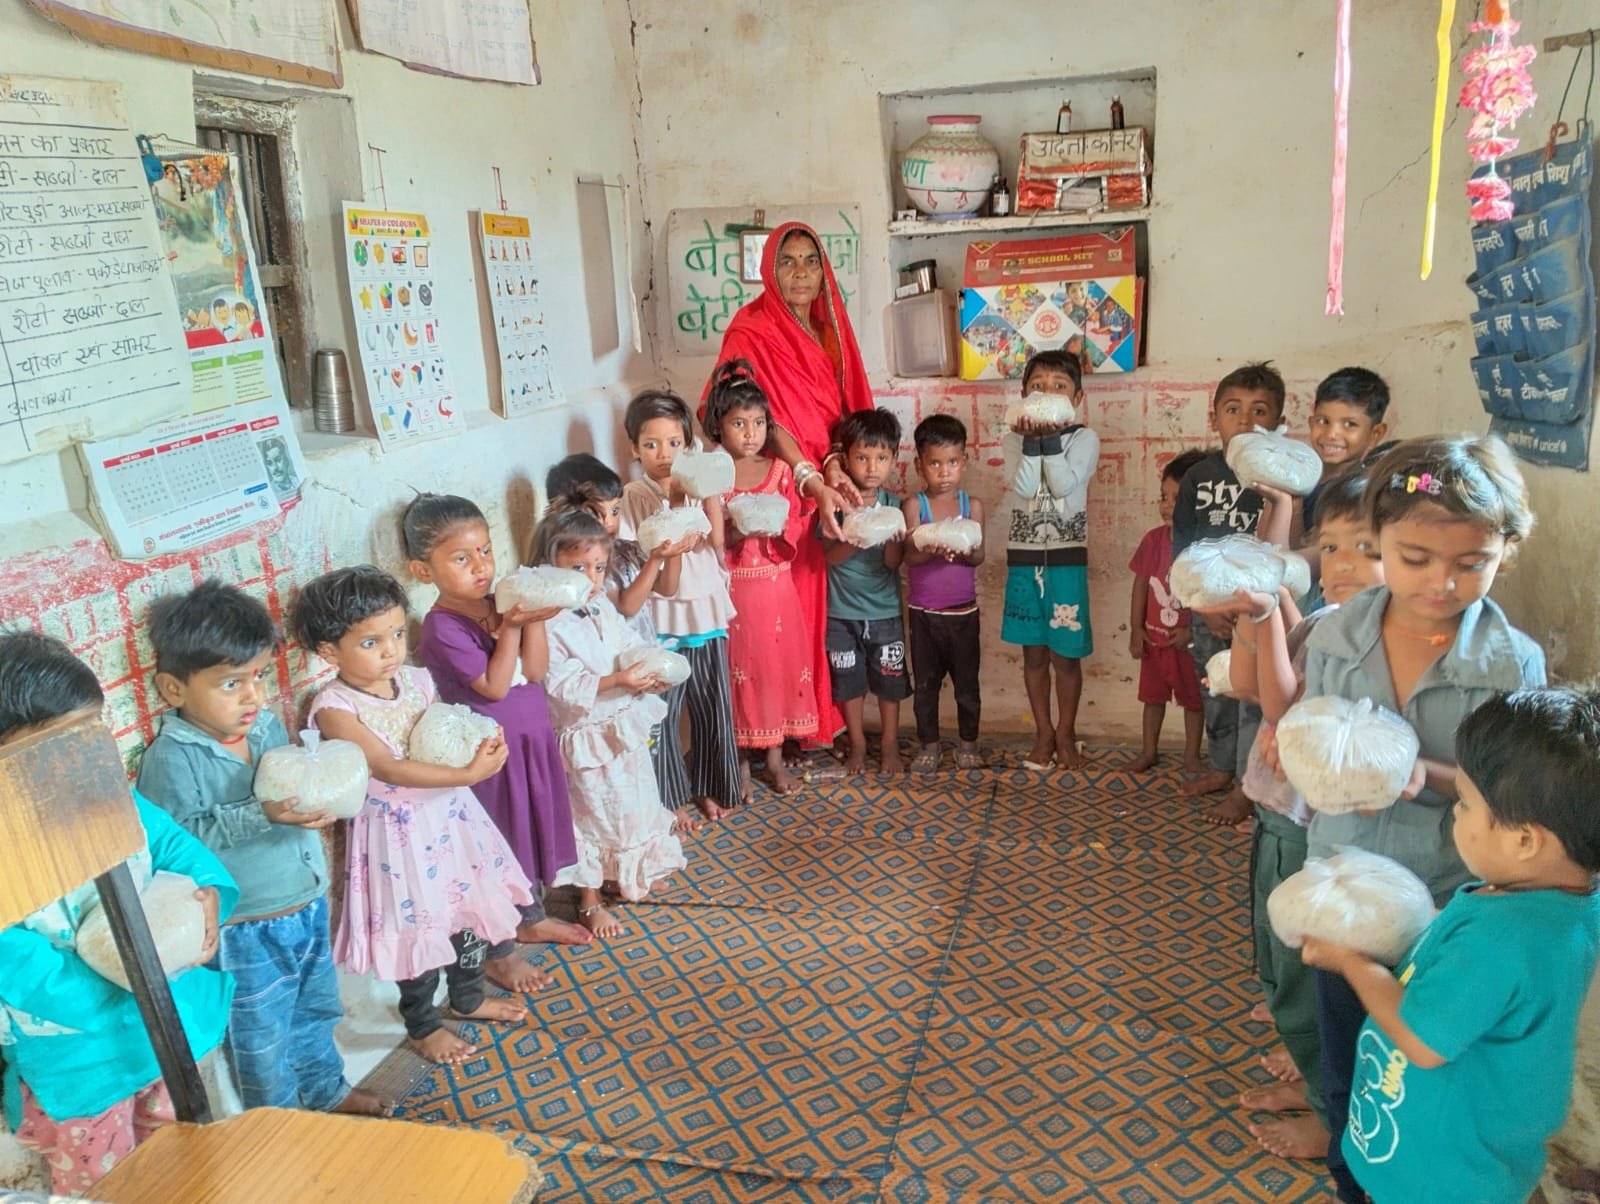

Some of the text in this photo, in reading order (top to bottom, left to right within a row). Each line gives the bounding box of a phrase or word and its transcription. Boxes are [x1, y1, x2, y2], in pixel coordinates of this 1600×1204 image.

[1028, 253, 1071, 266] SCHOOL
[1073, 251, 1095, 262] KIT
[1195, 479, 1247, 511] Sty
